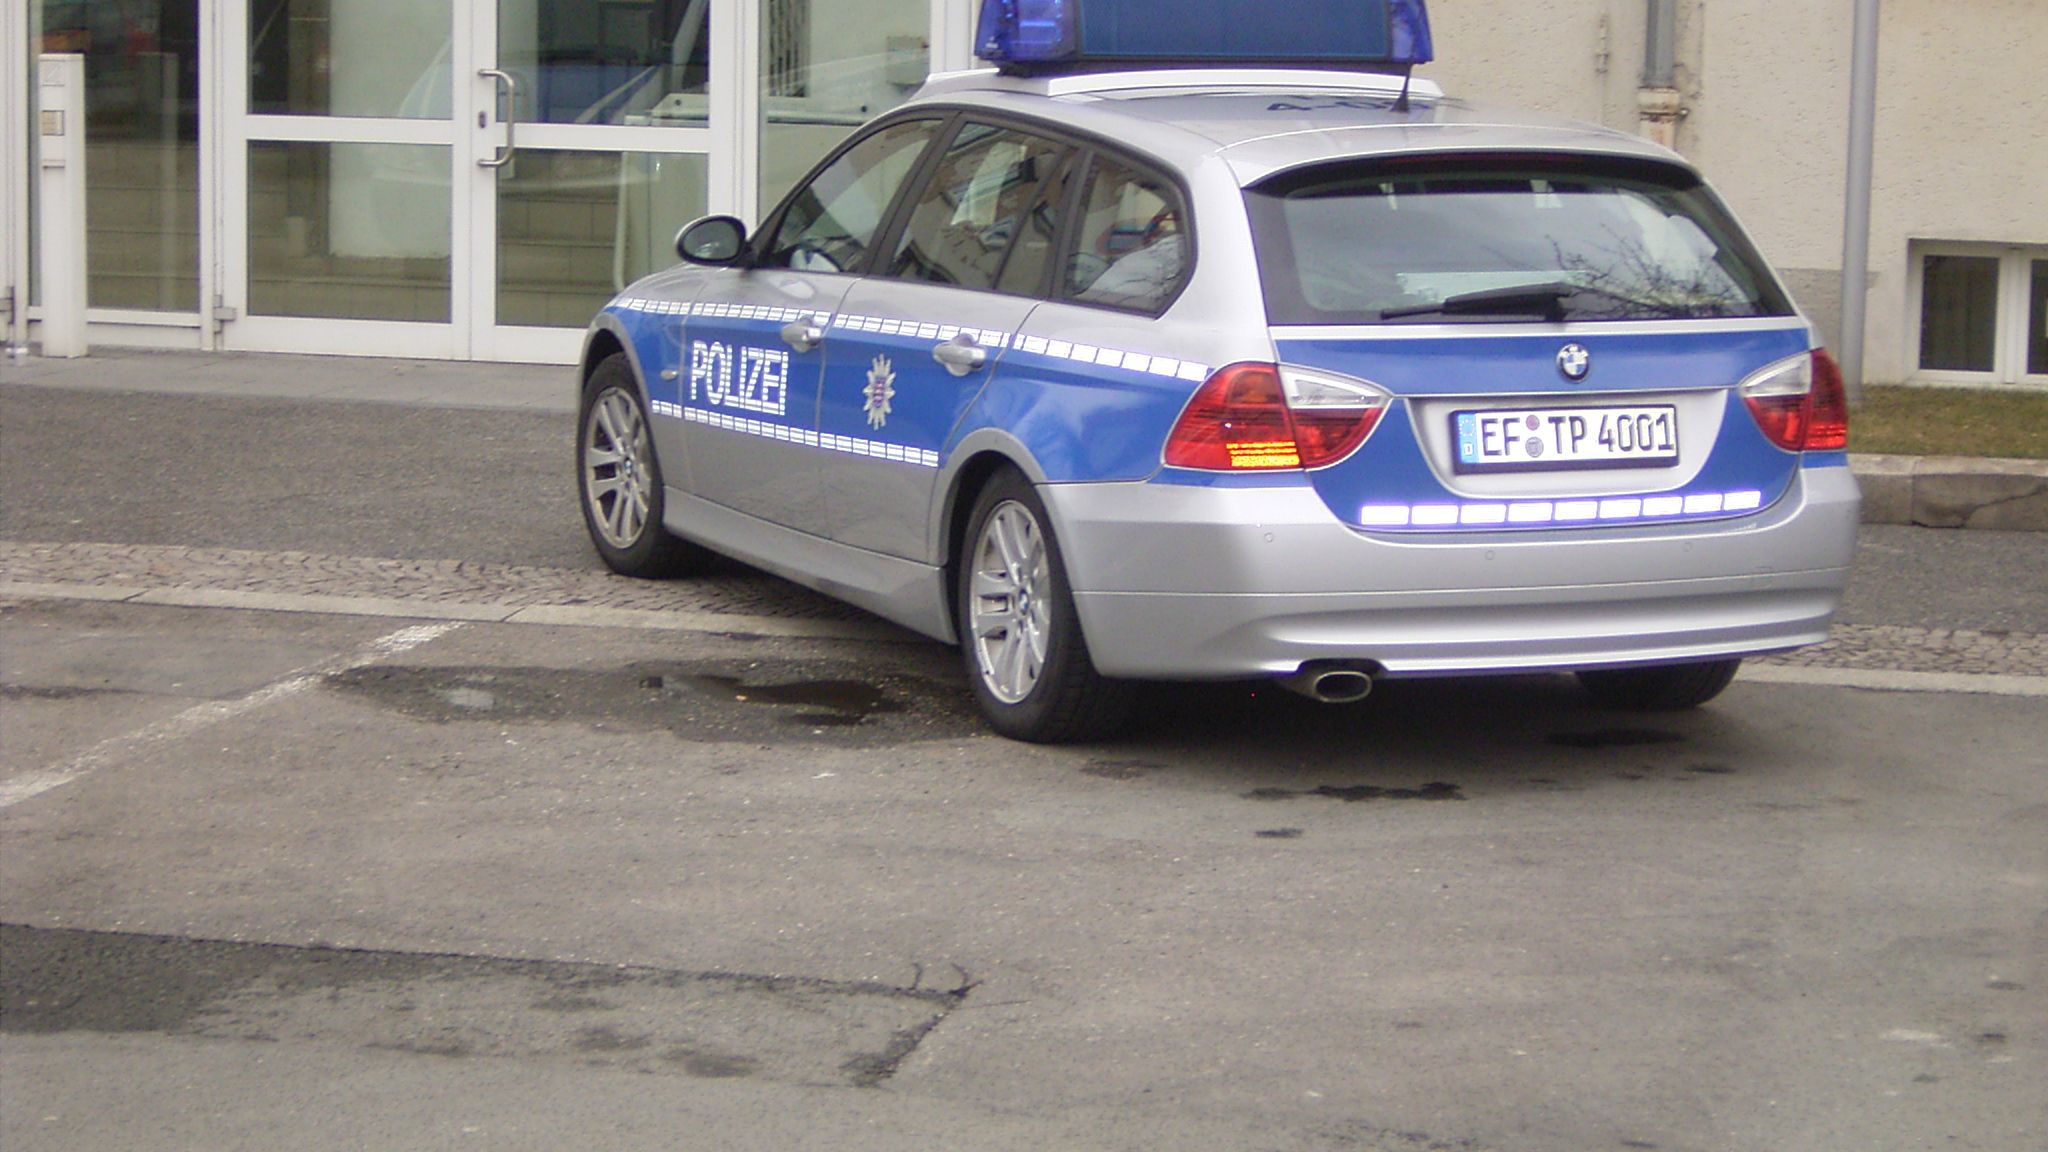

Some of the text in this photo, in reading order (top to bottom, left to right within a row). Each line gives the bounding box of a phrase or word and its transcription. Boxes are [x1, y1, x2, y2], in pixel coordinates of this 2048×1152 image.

[692, 341, 788, 415] POLIZEI
[1481, 414, 1674, 456] EF TP 4001
